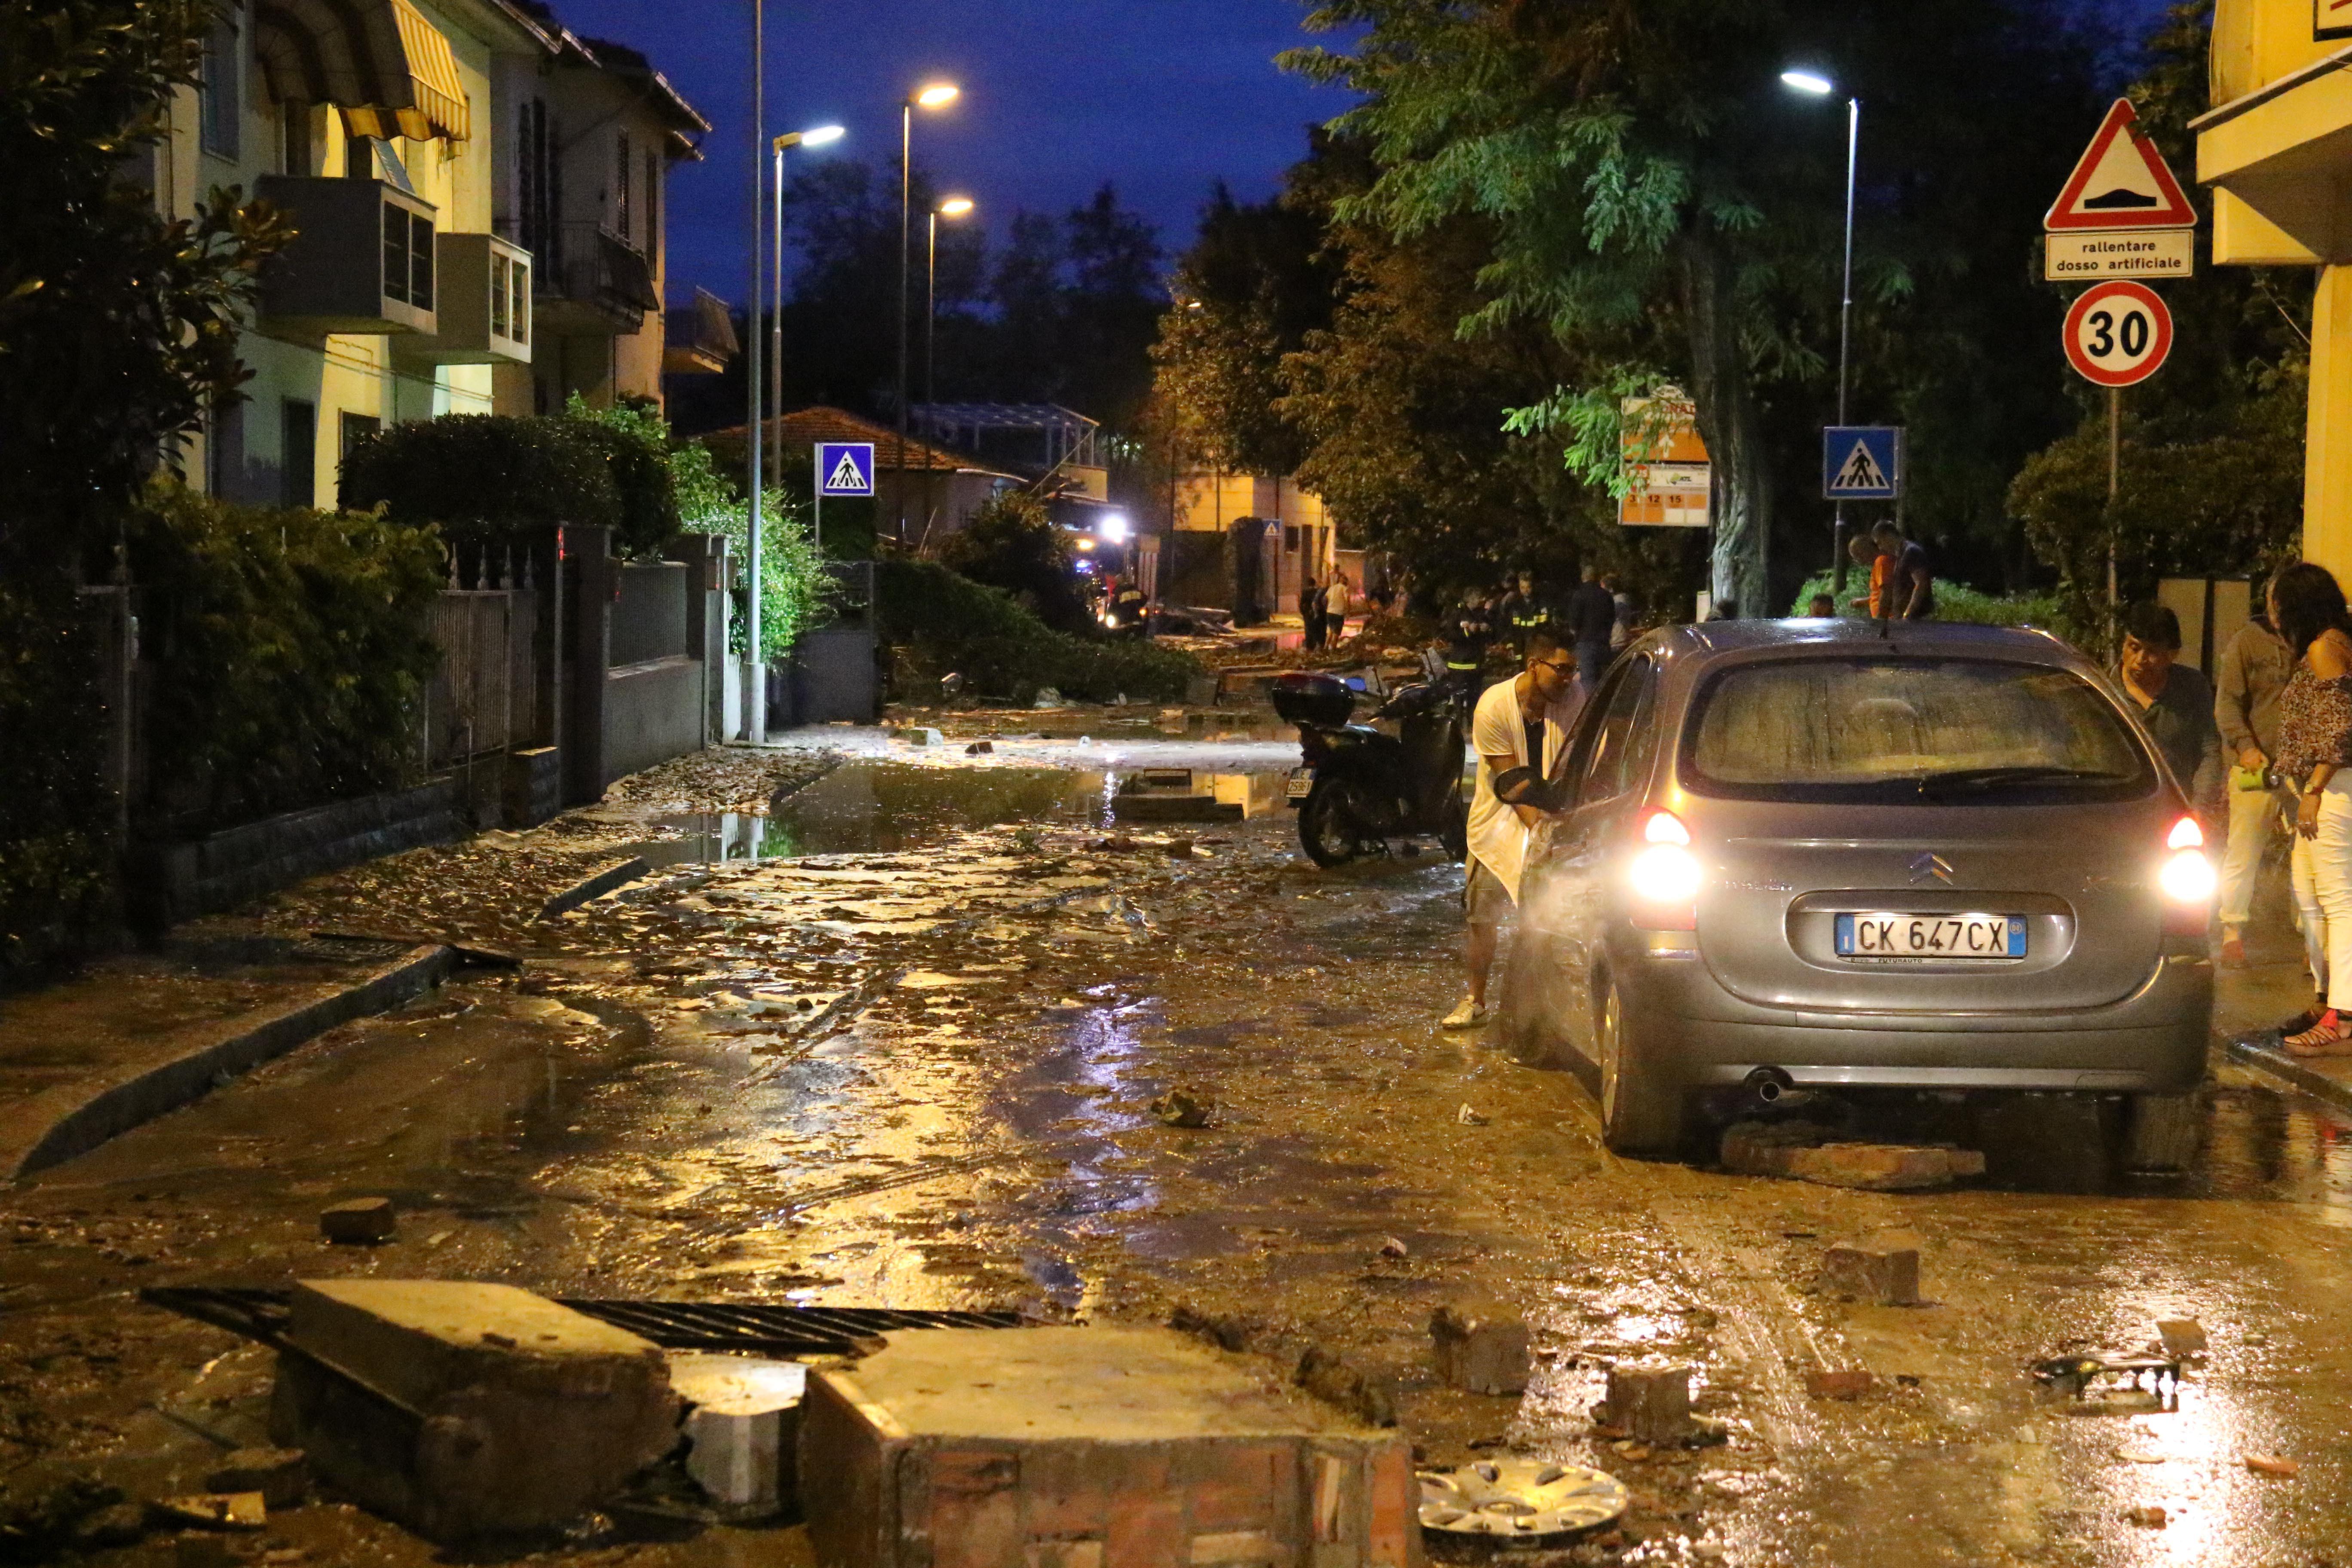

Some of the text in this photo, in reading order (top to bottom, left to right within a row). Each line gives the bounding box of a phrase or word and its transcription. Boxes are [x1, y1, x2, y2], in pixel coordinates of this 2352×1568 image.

[2082, 241, 2156, 253] rallentare
[2057, 257, 2181, 271] dosso artificiale
[2088, 310, 2148, 357] 30
[1648, 495, 1660, 503] 12
[1669, 495, 1681, 503] 15
[1860, 921, 1895, 950] CK
[1910, 921, 2003, 951] 647CX
